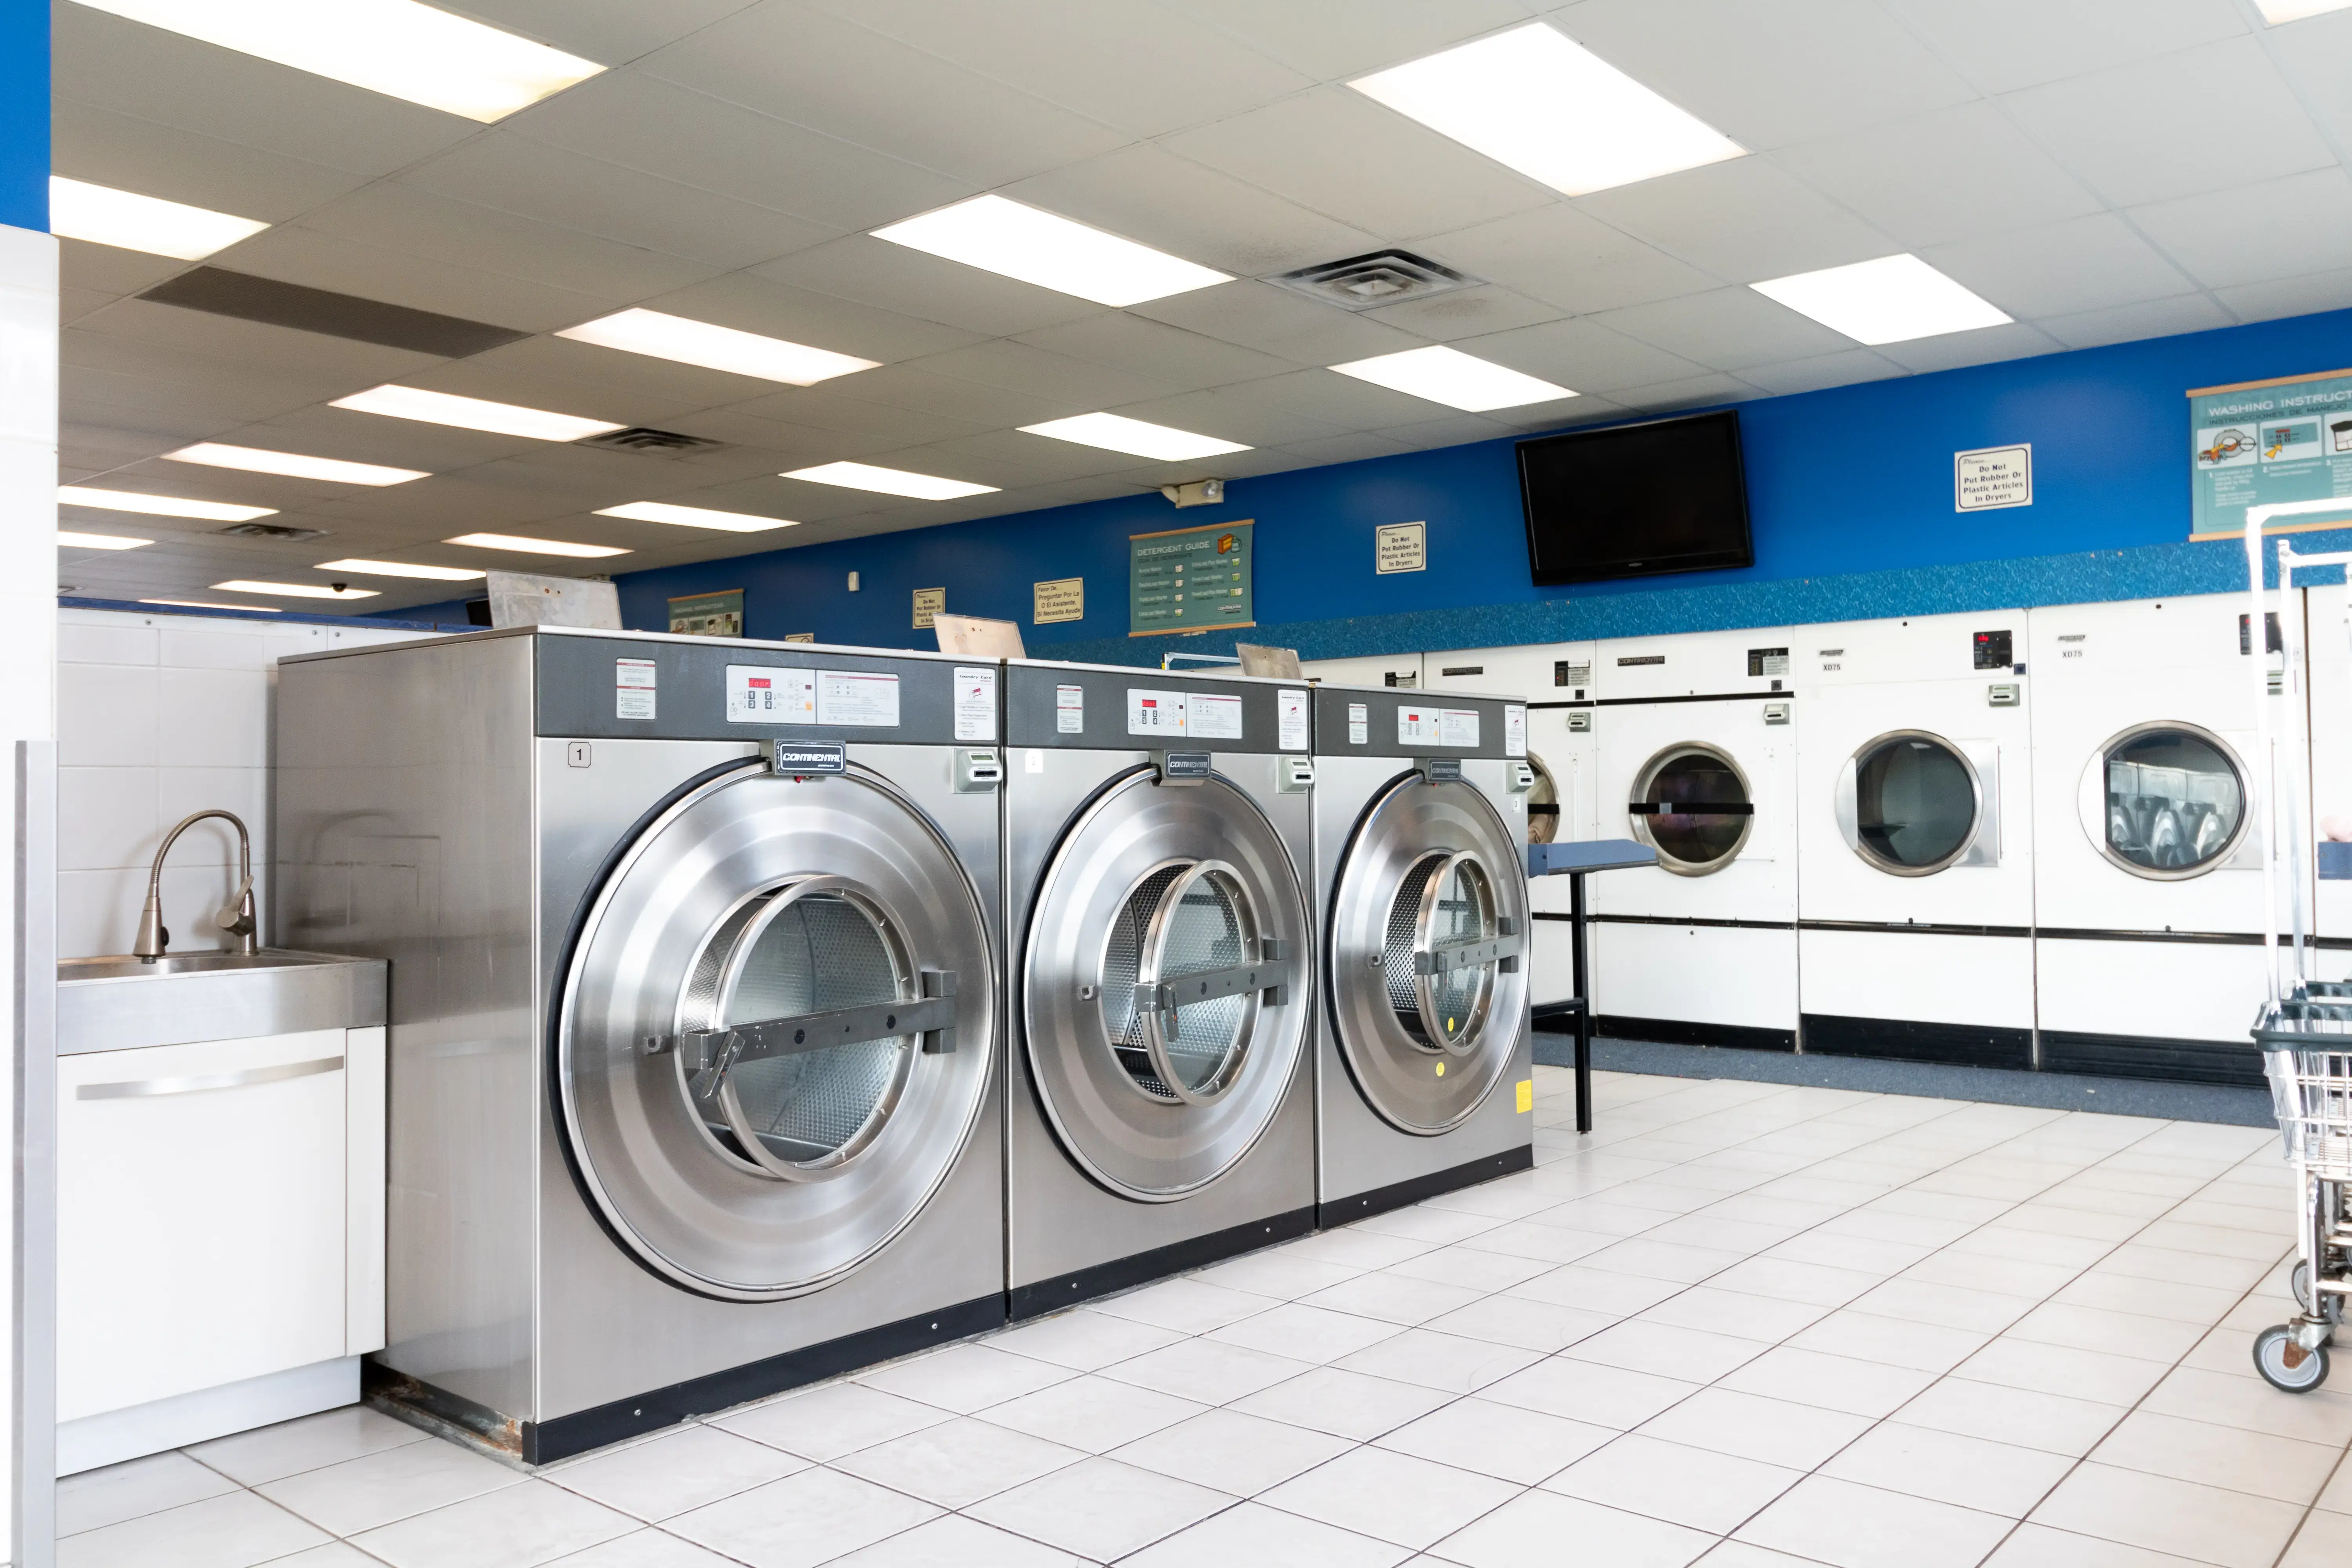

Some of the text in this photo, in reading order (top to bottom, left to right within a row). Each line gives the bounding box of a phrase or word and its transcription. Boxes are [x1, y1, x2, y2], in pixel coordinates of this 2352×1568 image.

[2209, 400, 2274, 416] WASHING
[2209, 410, 2284, 425] INSTRUCCIONES
[2307, 403, 2347, 413] MANEJO
[1980, 474, 2009, 482] Rubber
[1964, 482, 2023, 494] Plastic Articles
[1985, 493, 2011, 502] Dryers
[1138, 541, 1210, 556] DETERGENT GUIDE
[577, 749, 581, 760] 1
[783, 753, 840, 762] CONTINENTAL
[1032, 757, 1036, 765] 2
